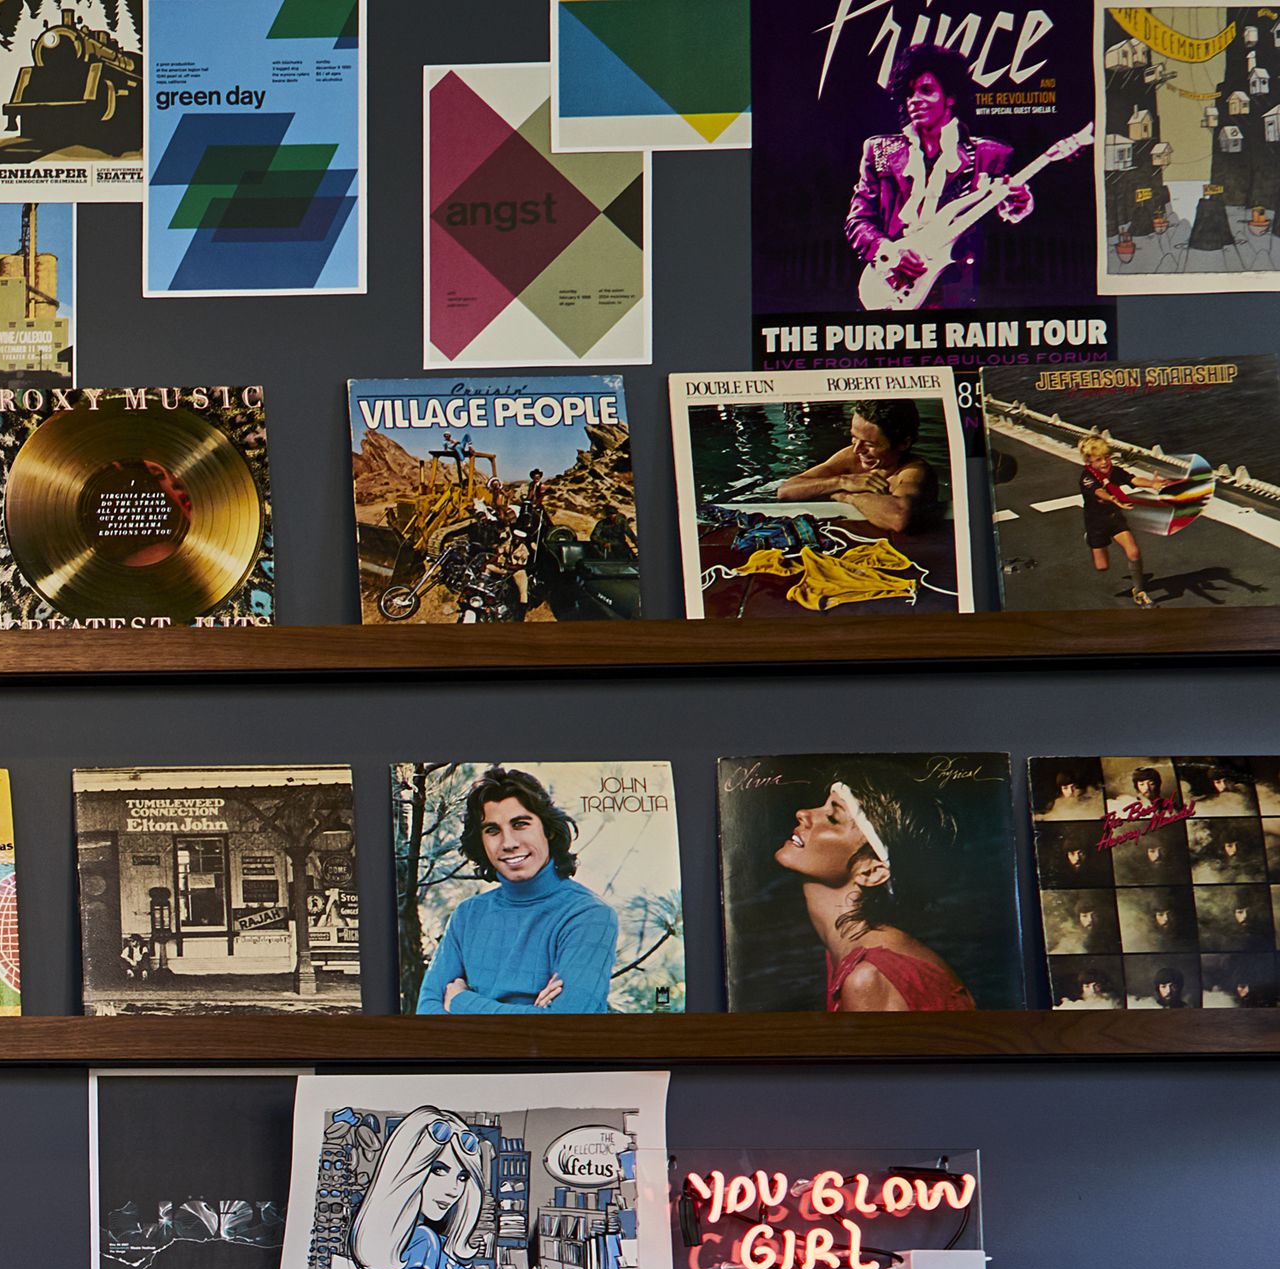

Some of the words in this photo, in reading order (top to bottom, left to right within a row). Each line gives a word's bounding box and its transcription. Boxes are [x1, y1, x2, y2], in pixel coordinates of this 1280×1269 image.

[1040, 79, 1056, 88] AND
[156, 90, 221, 111] green
[226, 85, 266, 110] day
[975, 93, 994, 105] THE
[996, 91, 1056, 104] REVOLUTION
[446, 192, 558, 232] angst
[762, 326, 818, 353] THE
[825, 323, 938, 351] PURPLE
[945, 321, 1020, 348] RAIN
[1025, 319, 1108, 346] TOUR
[812, 357, 869, 370] FROM
[878, 356, 919, 368] THE
[925, 353, 1030, 367] FABULOUS
[1036, 350, 1108, 365] FORUM
[827, 376, 883, 393] ROBERT
[885, 374, 942, 391] PALMER
[1035, 368, 1140, 391] JEFFERSON
[1145, 364, 1238, 387] STARSHIP
[450, 383, 529, 397] Cruisin'
[685, 381, 742, 397] DOUBLE
[744, 379, 776, 395] FUN
[124, 386, 262, 411] MUSIC
[357, 397, 489, 429] VILLAGE
[493, 395, 621, 428] PEOPLE
[597, 776, 648, 794] JOHN
[125, 798, 226, 809] TUMBLEWEED
[130, 807, 219, 818] CONNECTION
[580, 795, 668, 814] TRAVOLTA
[126, 817, 180, 832] Elton
[181, 817, 229, 832] John
[600, 1132, 615, 1143] THE
[573, 1143, 616, 1155] ELECTRIC
[687, 1169, 789, 1224] YOU
[811, 1170, 977, 1216] GLOW
